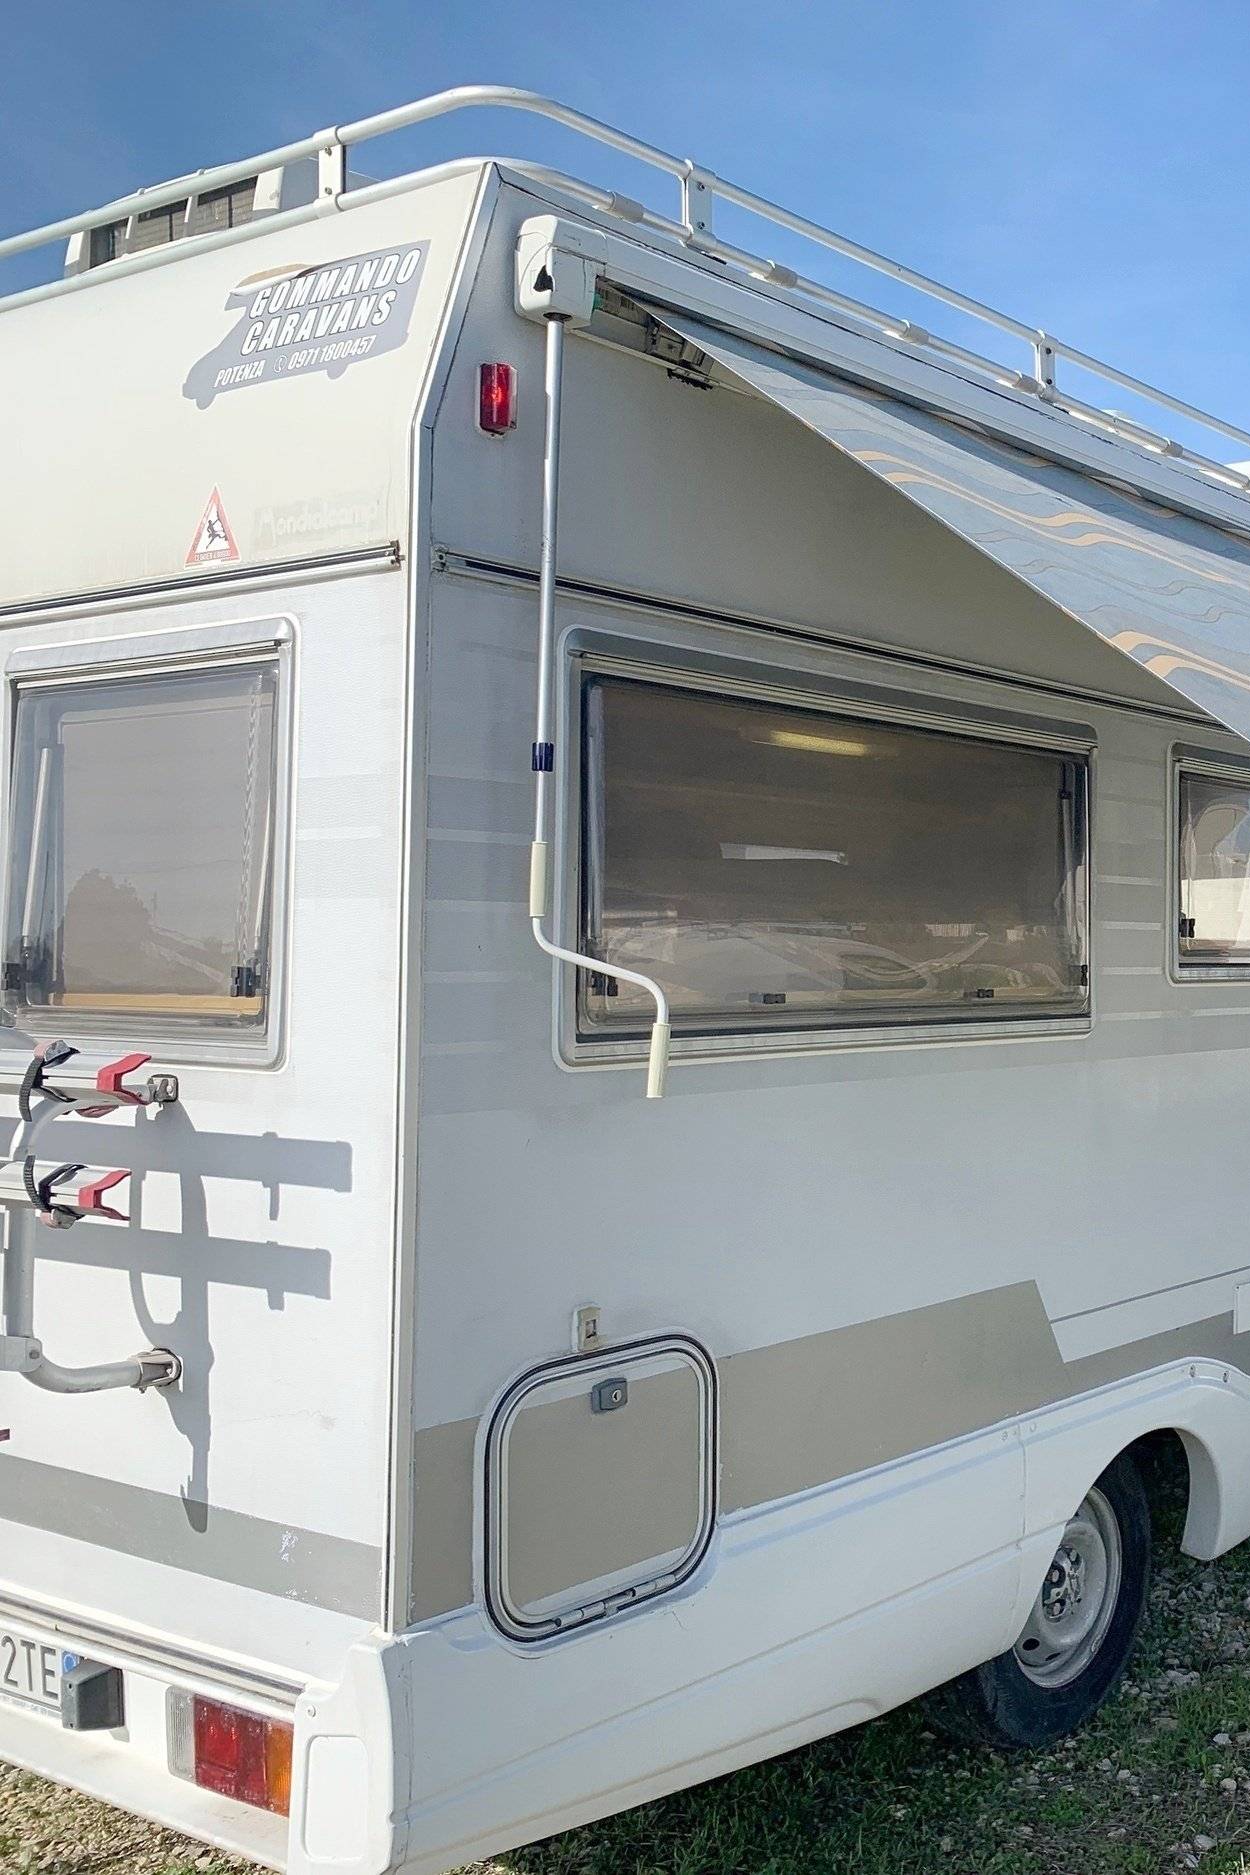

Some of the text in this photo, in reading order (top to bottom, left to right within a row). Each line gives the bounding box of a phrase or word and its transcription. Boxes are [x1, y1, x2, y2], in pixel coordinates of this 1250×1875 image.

[240, 290, 398, 356] CARAVANS
[214, 360, 266, 388] POTENZA
[1, 1635, 59, 1700] 2TE
